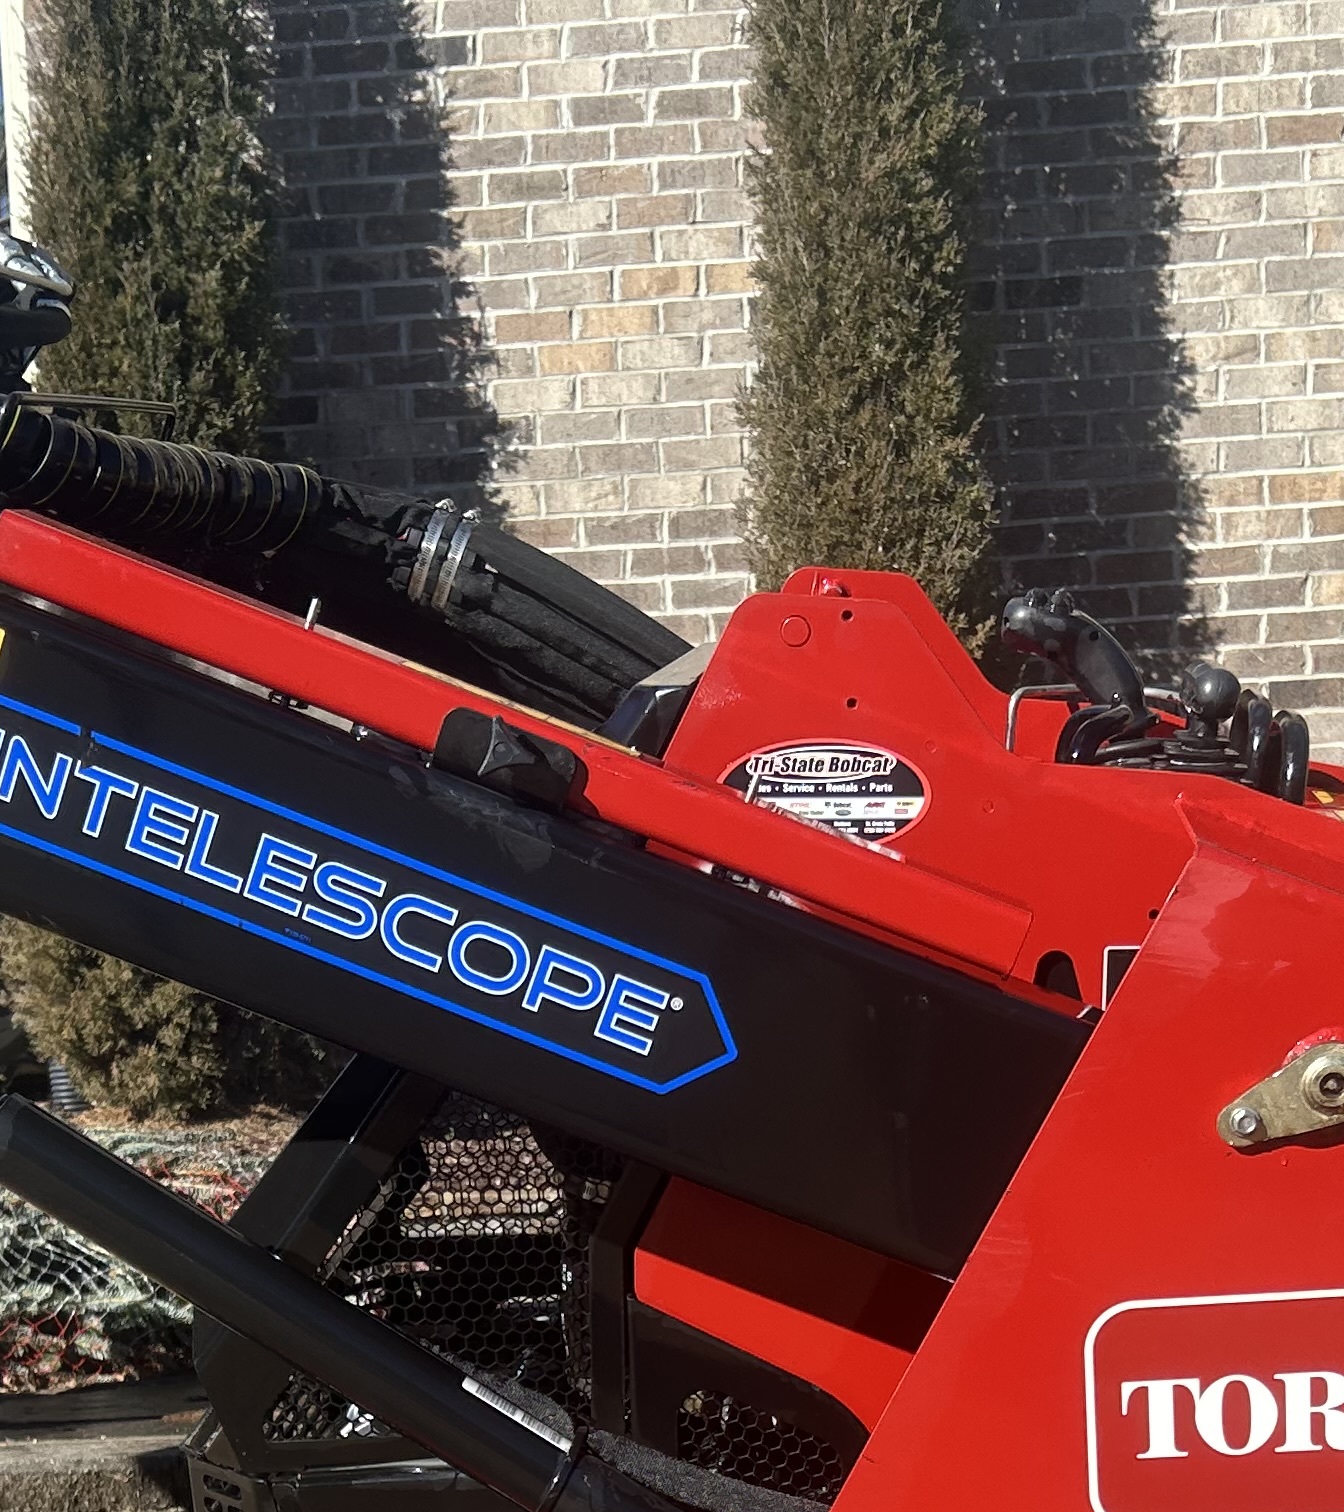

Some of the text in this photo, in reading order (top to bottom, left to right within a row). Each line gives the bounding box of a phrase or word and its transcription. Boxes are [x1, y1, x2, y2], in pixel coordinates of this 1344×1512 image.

[752, 756, 889, 773] Tri-State Bobcat
[782, 783, 815, 793] Service
[826, 783, 858, 793] Rentals
[869, 783, 893, 793] Parts
